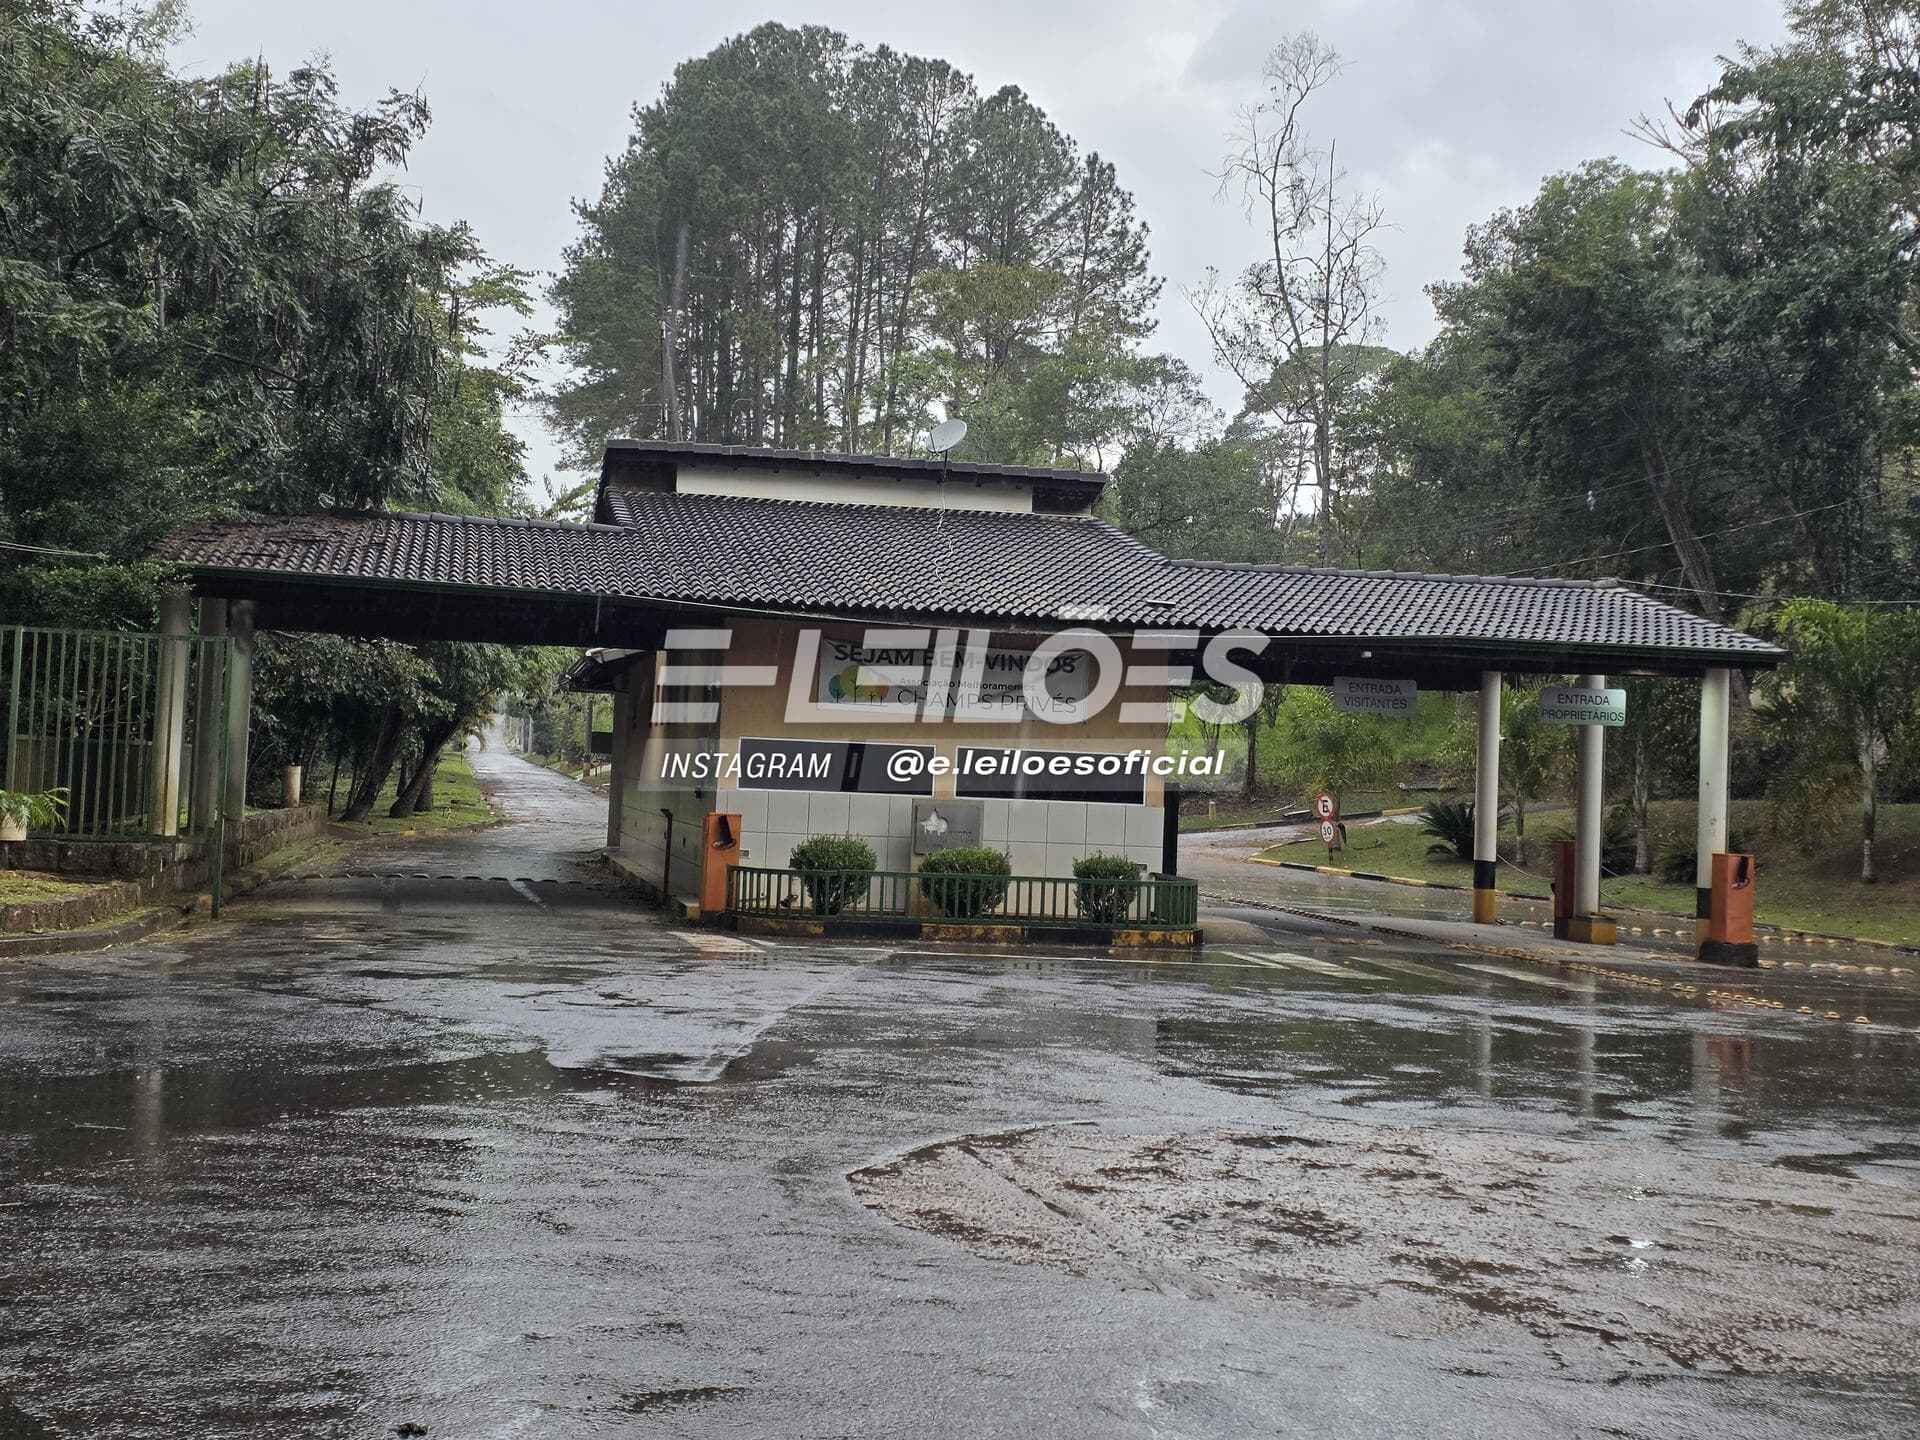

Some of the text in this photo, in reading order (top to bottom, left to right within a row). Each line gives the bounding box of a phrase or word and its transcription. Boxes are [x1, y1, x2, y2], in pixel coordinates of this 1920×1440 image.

[835, 644, 1076, 673] SEJAM BEM-VINDOS
[958, 681, 1036, 692] Melhoramen
[1348, 682, 1402, 695] ENTRADA
[898, 689, 1077, 713] CHAMPS PRIVÉS
[1344, 696, 1408, 710] VISITANTES
[1557, 693, 1610, 706] ENTRADA
[1541, 709, 1625, 721] PROPRIETÁRIOS
